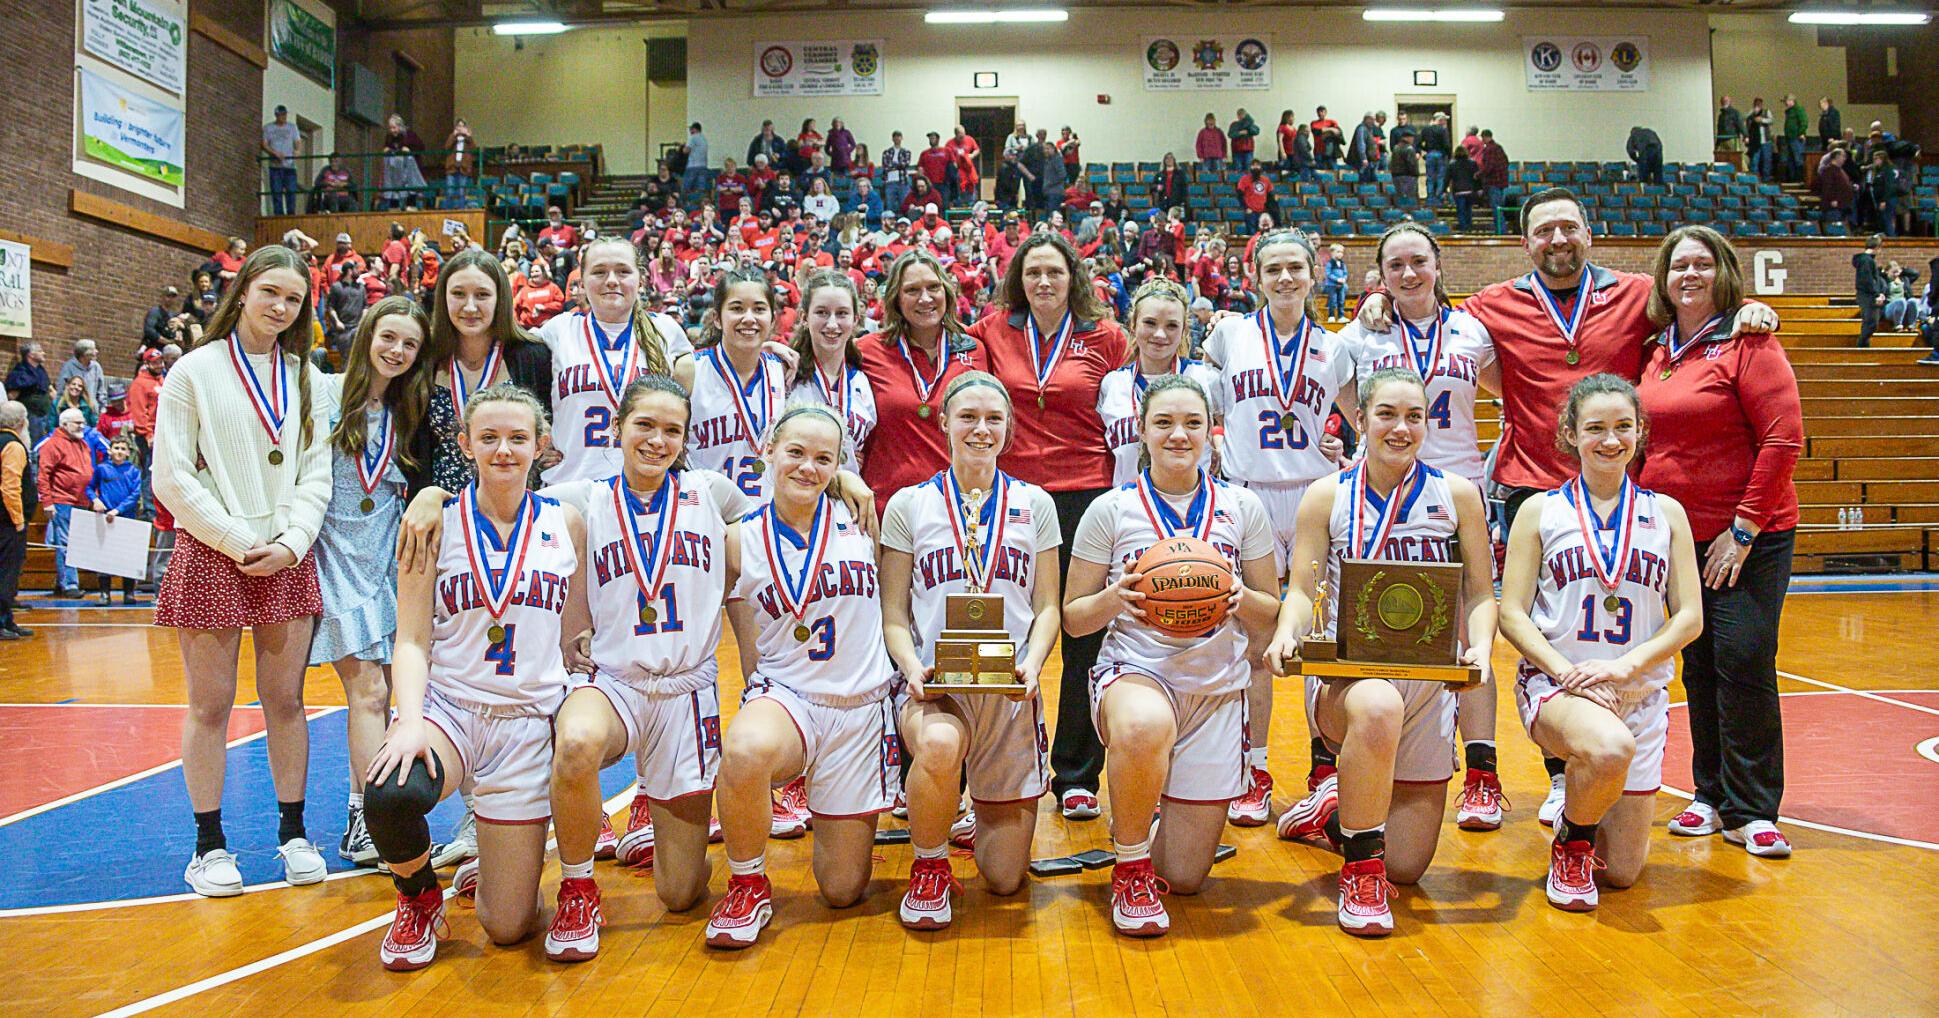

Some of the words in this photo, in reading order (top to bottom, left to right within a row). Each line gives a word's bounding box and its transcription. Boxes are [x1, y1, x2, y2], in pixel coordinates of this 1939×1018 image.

[94, 111, 122, 129] Building
[1754, 251, 1787, 295] G
[584, 406, 621, 448] 2
[1258, 410, 1309, 450] 20
[723, 456, 762, 497] 12
[1152, 574, 1219, 593] SPALDING
[634, 583, 683, 636] 11
[1155, 603, 1216, 619] LEGACY
[1577, 594, 1633, 645] 13
[485, 624, 516, 675] 4
[808, 615, 836, 661] 3
